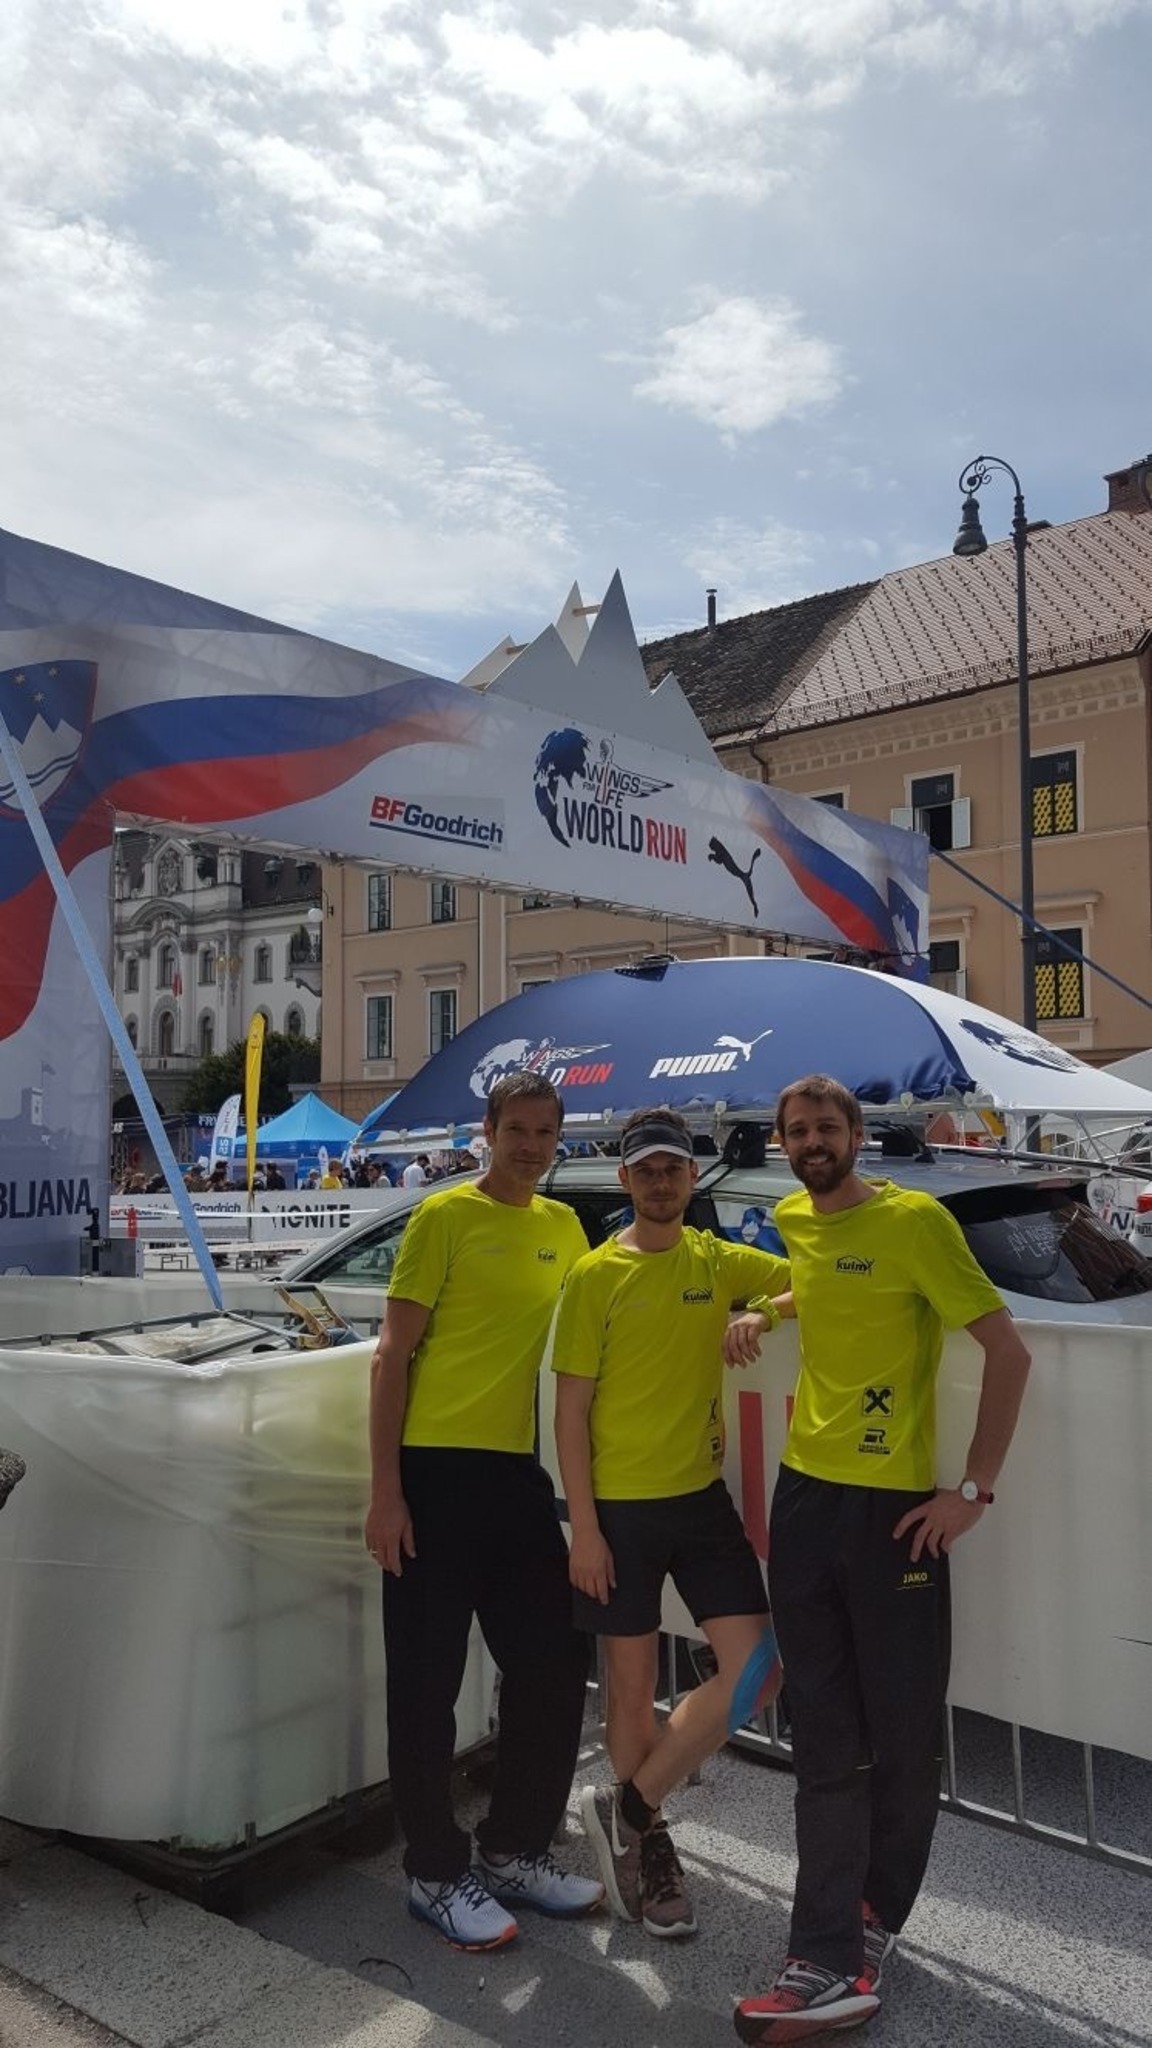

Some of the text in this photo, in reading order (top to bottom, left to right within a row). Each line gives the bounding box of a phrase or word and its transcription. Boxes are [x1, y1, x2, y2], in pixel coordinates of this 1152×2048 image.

[586, 761, 641, 793] WINGS
[594, 784, 625, 809] LIFE
[370, 795, 503, 843] BFGoodrich
[563, 797, 687, 865] WORLD RUN
[562, 1063, 614, 1086] RUN
[281, 1204, 351, 1229] IGNITE
[903, 1572, 928, 1584] JAKO
